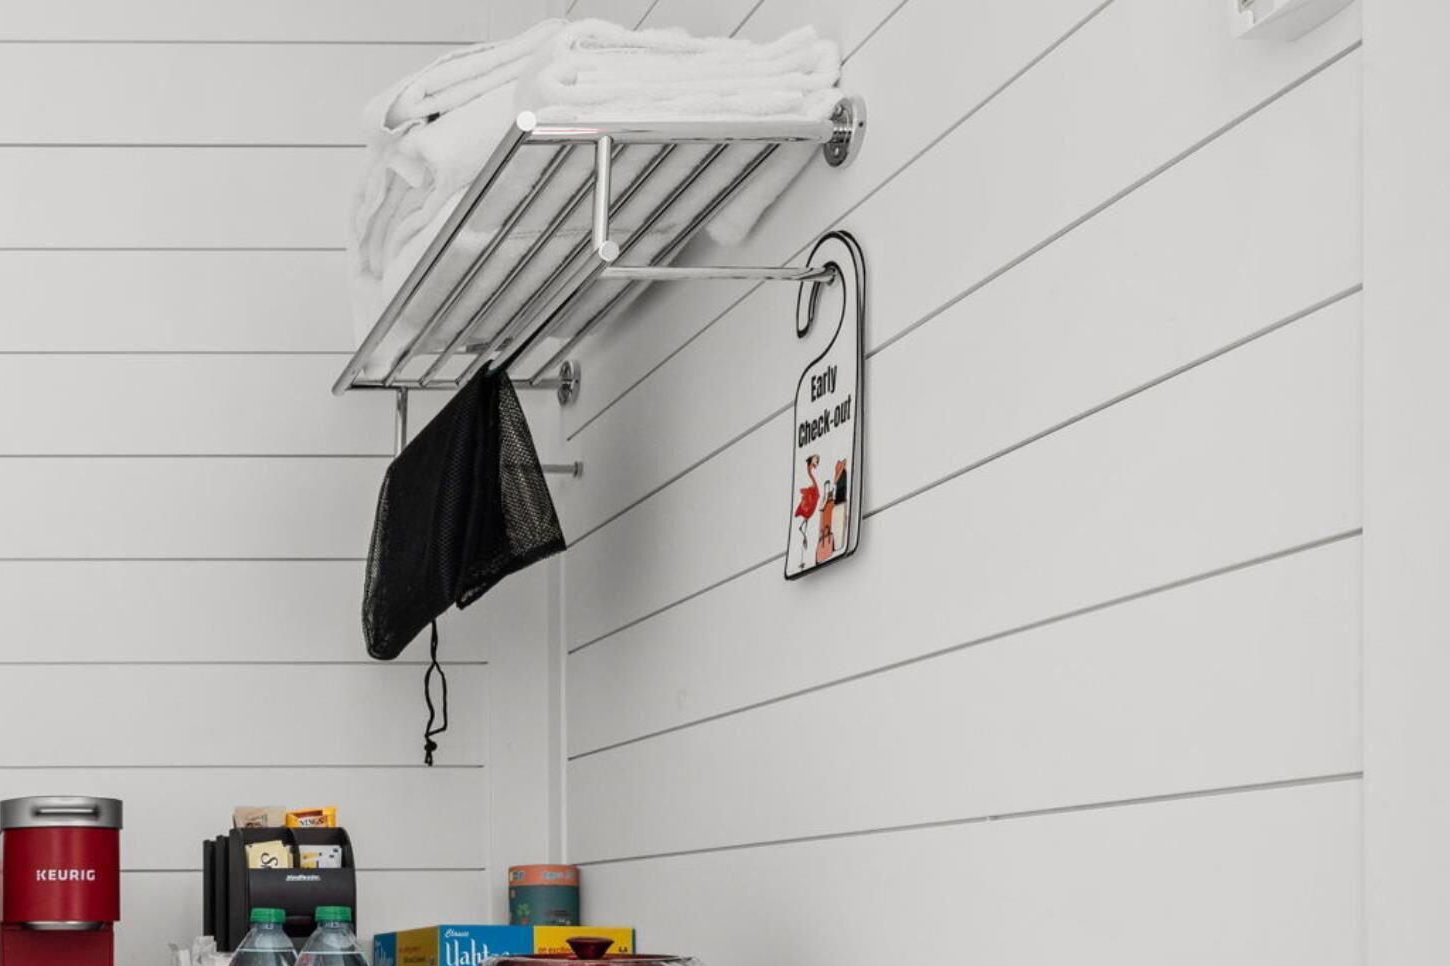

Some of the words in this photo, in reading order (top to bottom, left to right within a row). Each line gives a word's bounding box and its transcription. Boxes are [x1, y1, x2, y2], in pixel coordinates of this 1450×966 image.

[811, 364, 837, 402] Early
[798, 395, 852, 448] Check-out
[36, 869, 96, 881] KEURIG
